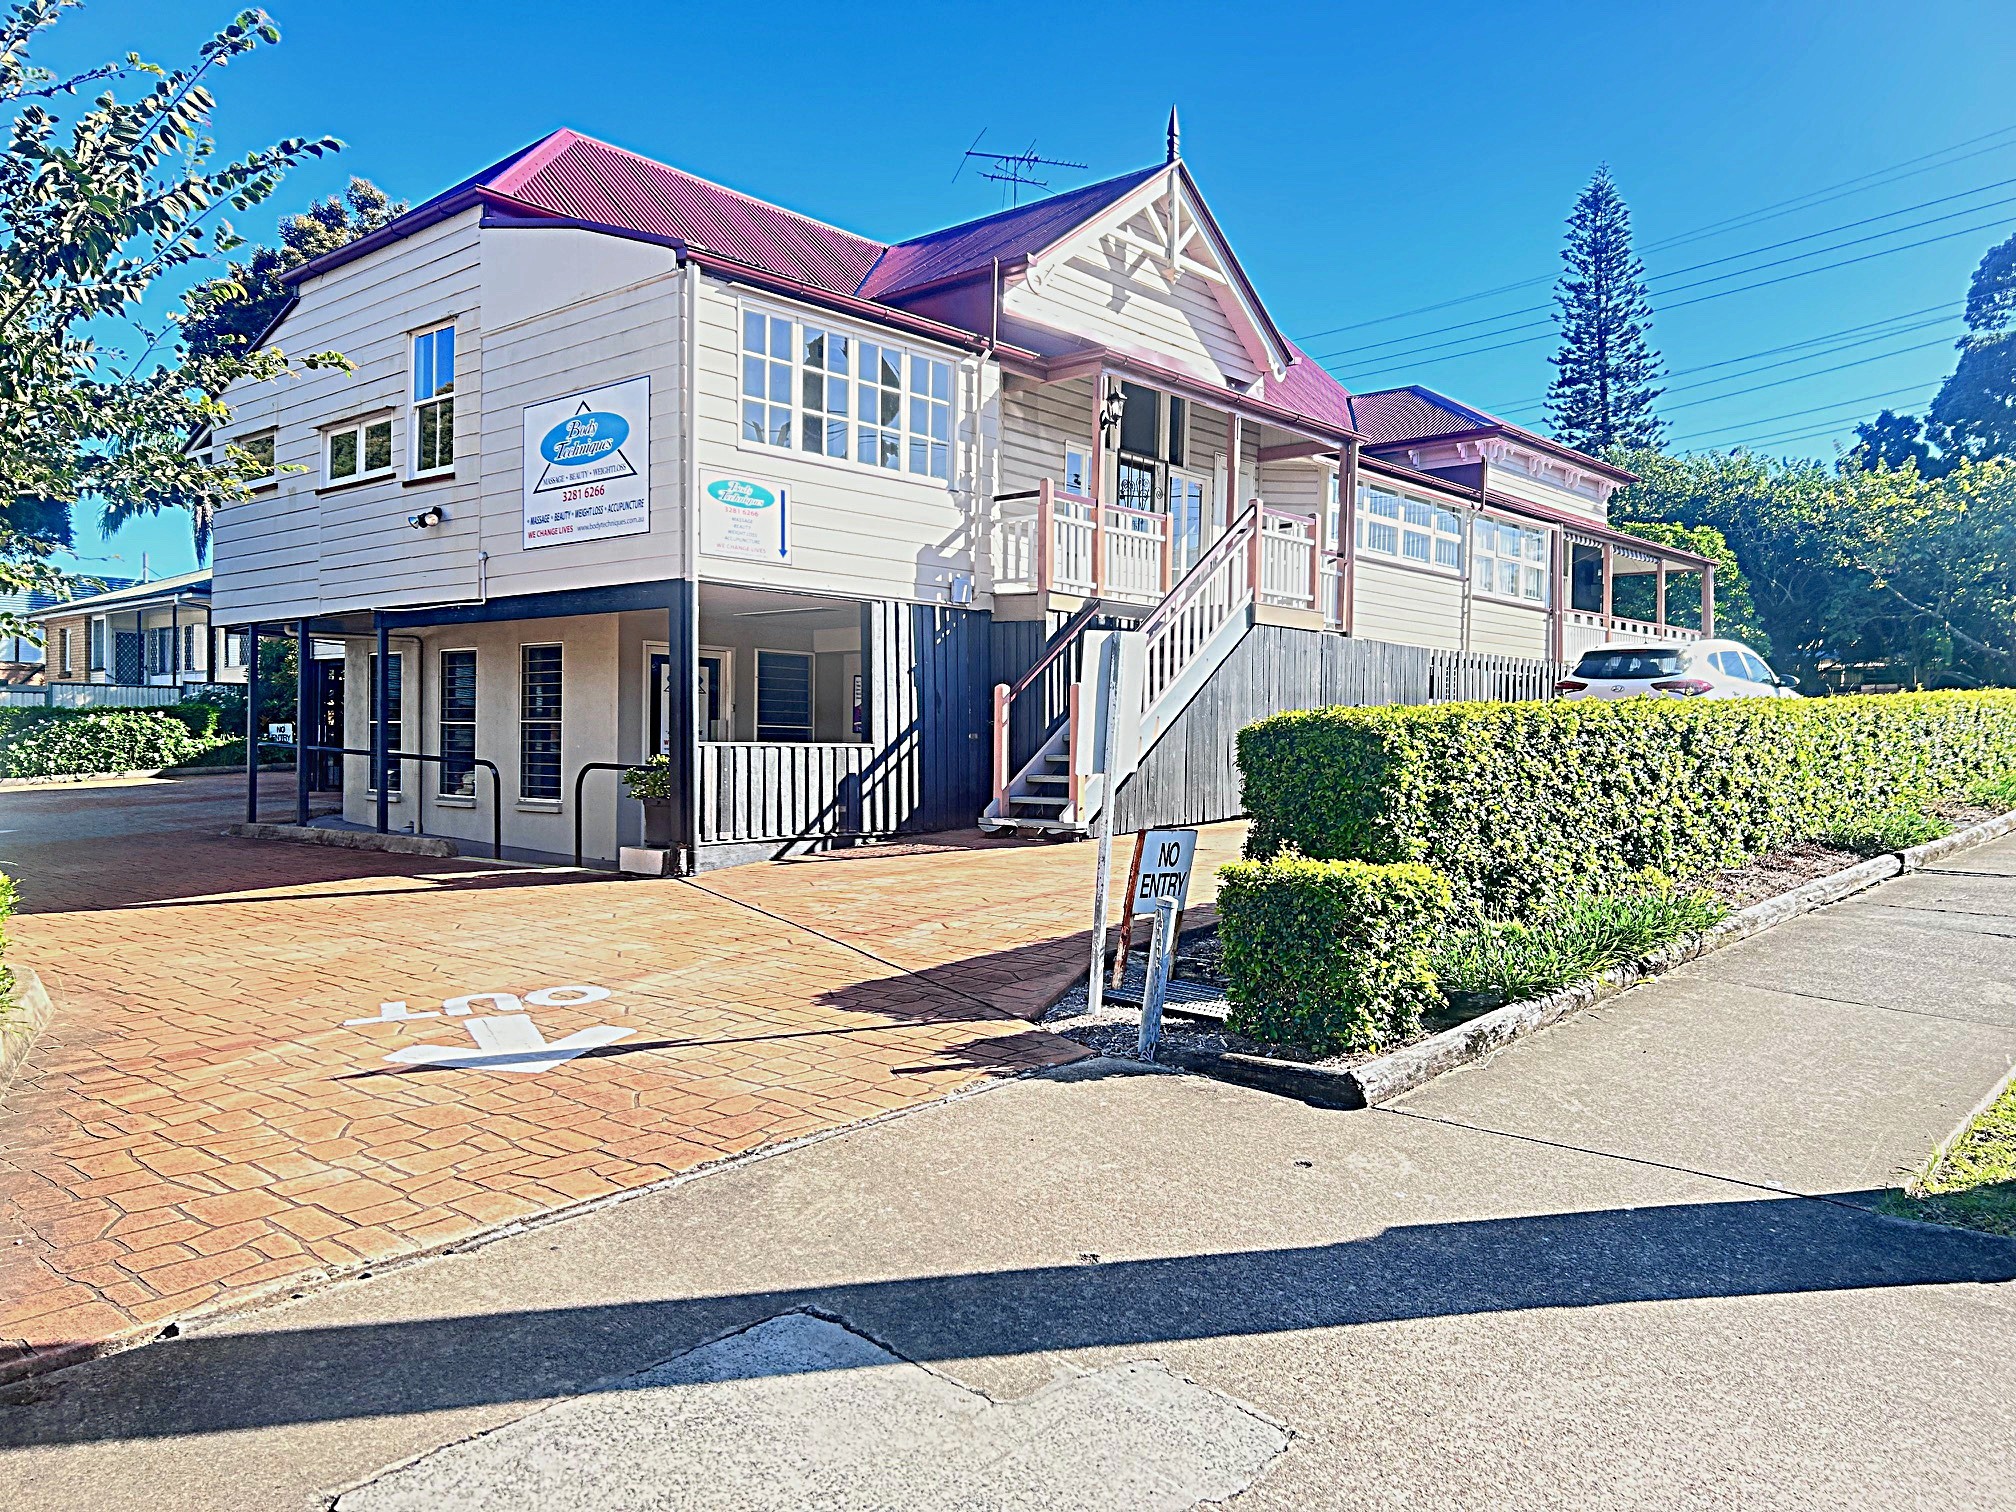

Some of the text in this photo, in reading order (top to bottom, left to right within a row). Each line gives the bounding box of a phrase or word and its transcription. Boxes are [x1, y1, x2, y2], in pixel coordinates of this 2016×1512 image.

[567, 419, 600, 440] Body
[555, 440, 614, 460] Techniques
[542, 475, 565, 486] MASSAGE
[569, 471, 588, 481] BEAUTY
[562, 485, 606, 502] 3281 6266
[530, 499, 645, 525] MASSAGE BEAUTY WEIGHT LOSS ACCUPUNCTURE
[725, 506, 740, 514] 3281
[528, 517, 645, 539] WE CHANGE LIVES www.bodytechniques.com.au
[1158, 842, 1181, 868] NO
[1139, 871, 1188, 898] ENTRY
